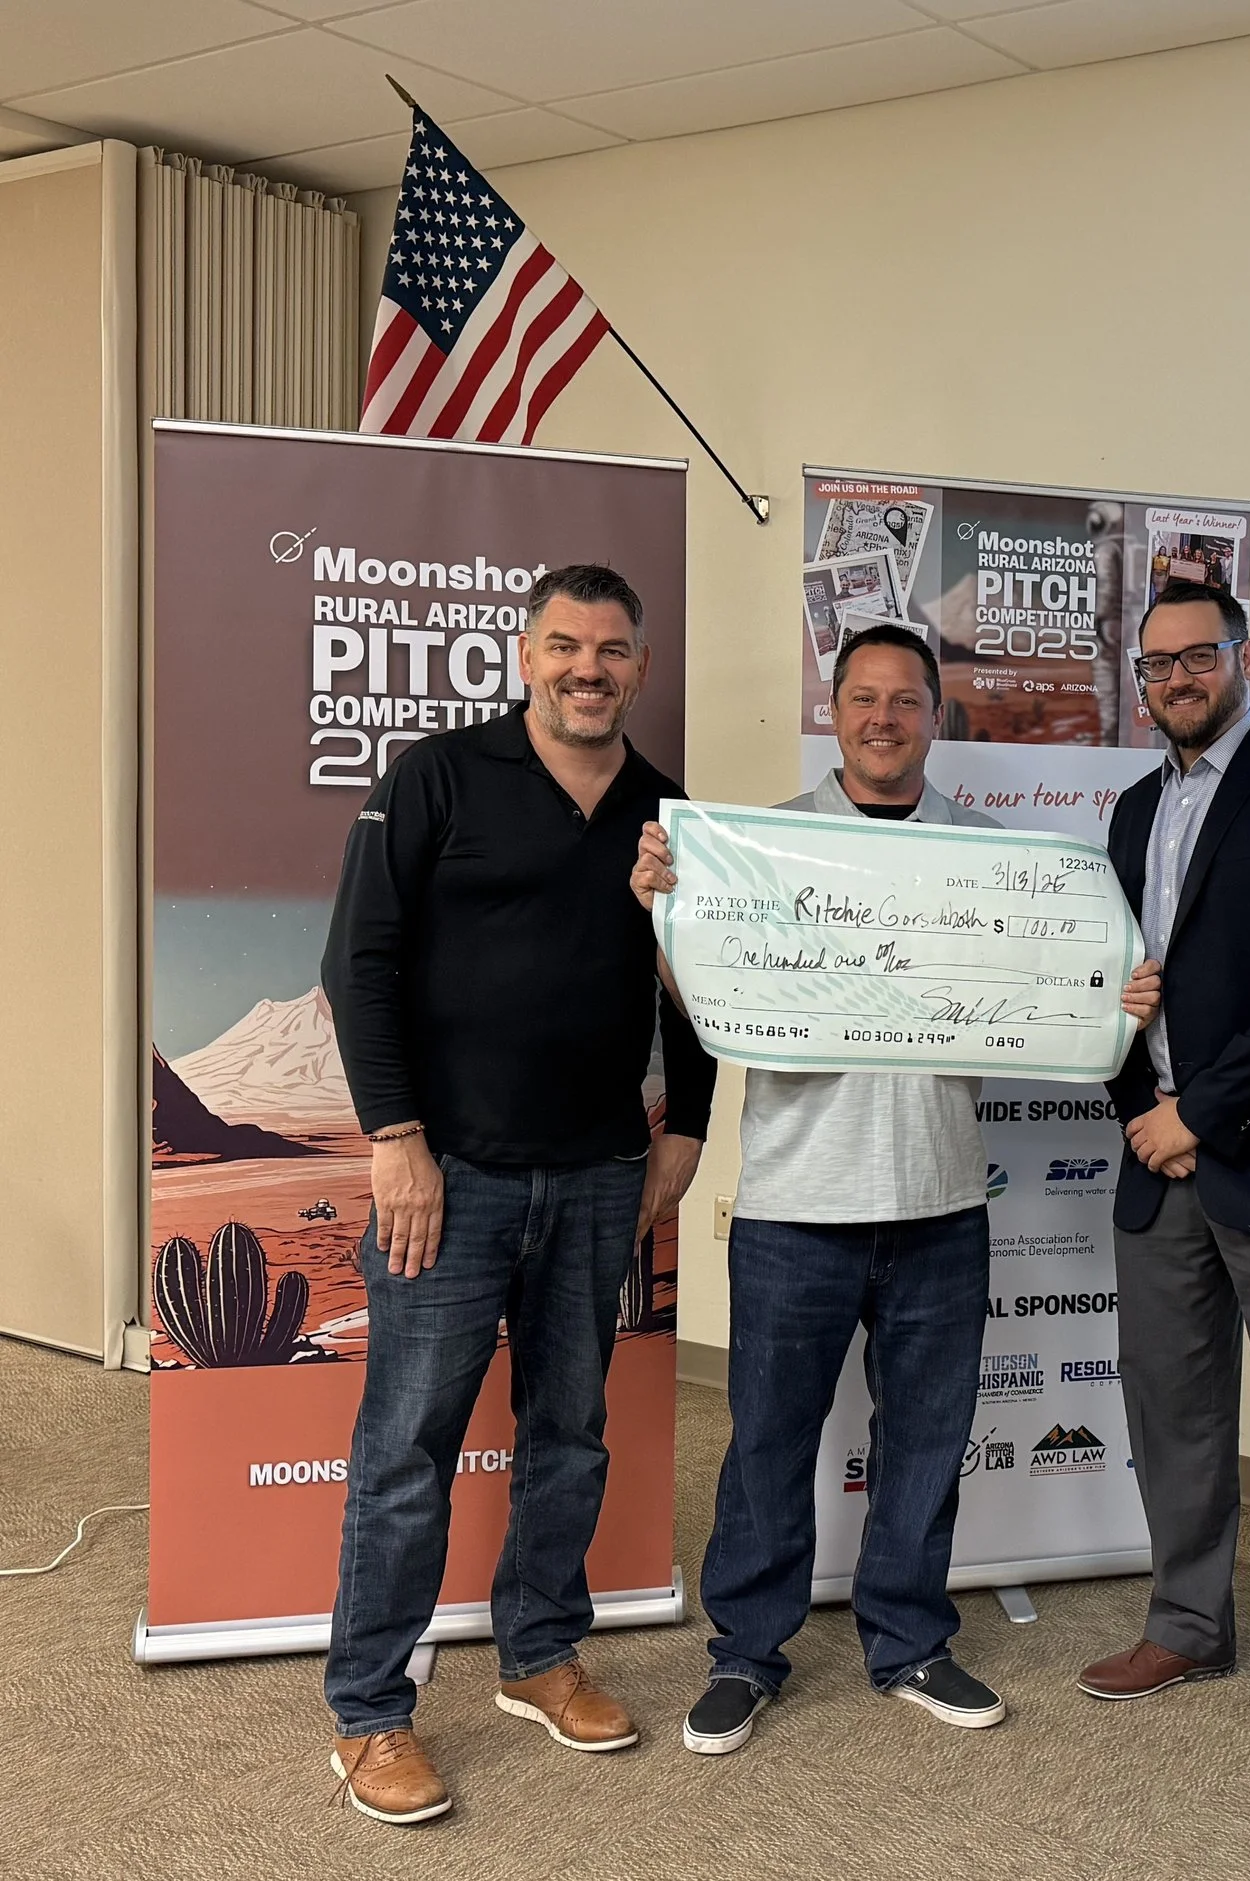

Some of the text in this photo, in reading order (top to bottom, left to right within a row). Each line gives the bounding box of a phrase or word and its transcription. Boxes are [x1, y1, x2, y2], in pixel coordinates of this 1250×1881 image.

[819, 483, 918, 495] JOIN US ON THE ROAD!
[856, 501, 880, 514] Vegas
[1151, 510, 1242, 530] Last Year's Winner!
[840, 515, 854, 551] Colorado
[855, 531, 890, 543] ARIZONA
[978, 530, 1094, 558] Moonshot
[978, 552, 1096, 574] RURAL ARIZONA
[977, 569, 1097, 613] PITCH
[314, 595, 418, 626] RURAL
[975, 606, 1095, 630] COMPETITION
[975, 623, 1098, 661] 2025
[973, 667, 1018, 677] Presented by
[1035, 682, 1055, 693] aps
[1060, 683, 1098, 692] ARIZONA
[310, 694, 512, 729] COMPETIT
[953, 783, 975, 808] to
[984, 790, 1026, 808] our
[1033, 782, 1085, 807] tour
[1059, 857, 1107, 874] 1223477
[946, 877, 979, 889] DATE
[696, 895, 780, 911] PAY TO THE
[794, 886, 875, 928] Ritchie
[695, 909, 768, 923] ORDER OF
[993, 918, 1005, 933] $
[1036, 976, 1086, 988] DOLLARS
[691, 994, 727, 1008] MEMO
[985, 1036, 1025, 1048] 0890
[1045, 1158, 1109, 1181] SRP
[1045, 1187, 1083, 1197] Delivering
[1086, 1187, 1106, 1195] water
[1017, 1234, 1073, 1246] Association
[1075, 1232, 1091, 1244] for
[1028, 1243, 1095, 1257] Development
[982, 1353, 1038, 1372] TUCSON
[1060, 1359, 1121, 1383] RESOL
[978, 1370, 1044, 1390] HISPANIC
[985, 1441, 1014, 1450] ARIZONA
[985, 1449, 1015, 1458] STITCH
[985, 1457, 1015, 1471] LAB
[1030, 1447, 1106, 1467] AWD LAW
[250, 1459, 350, 1486] MOONS
